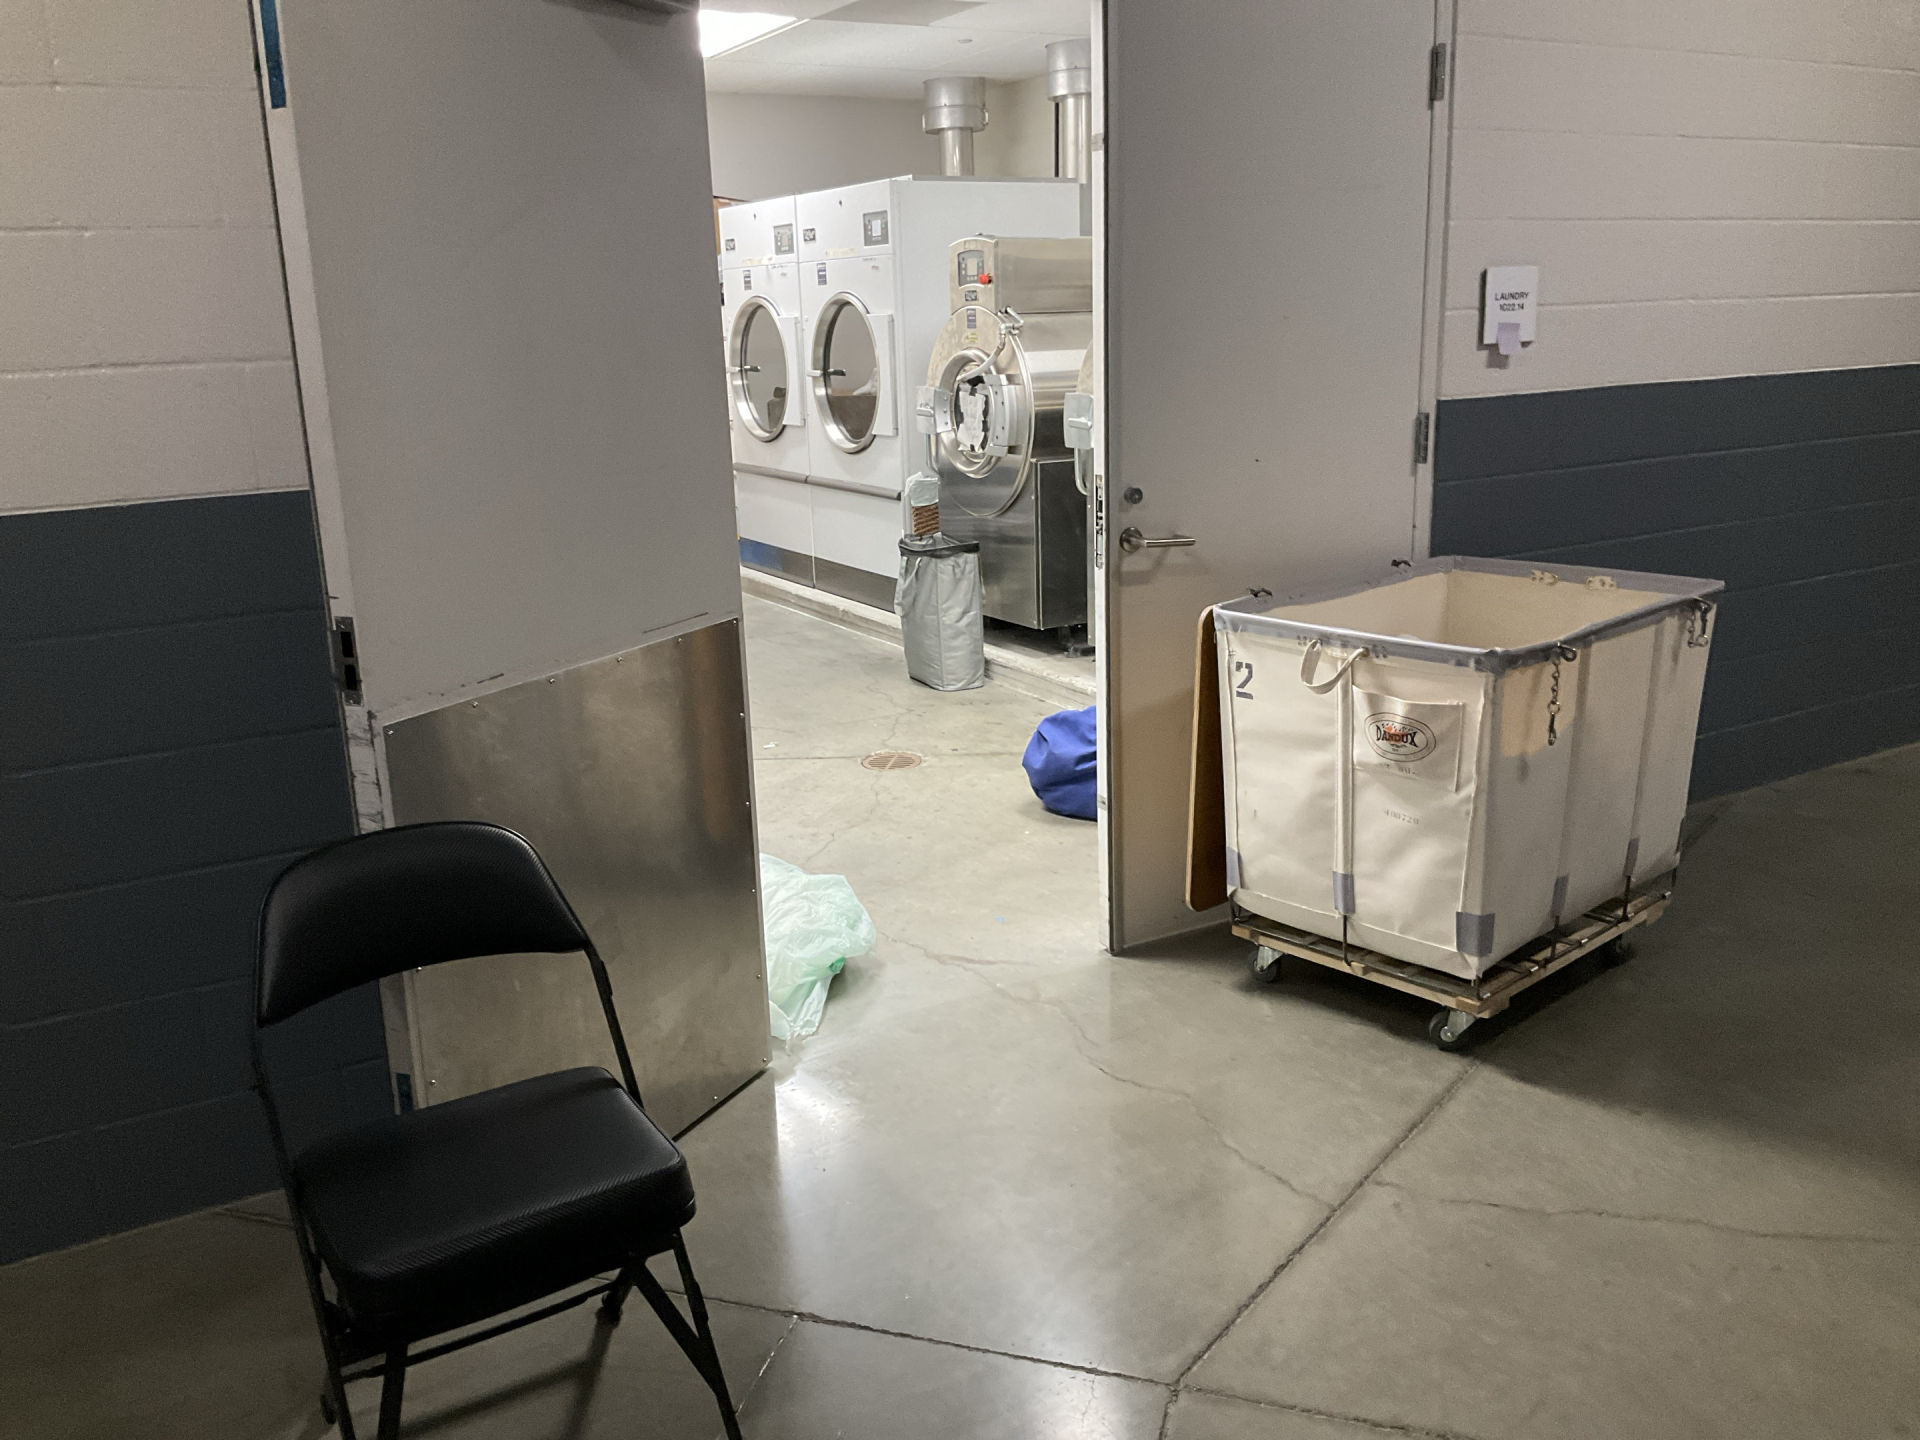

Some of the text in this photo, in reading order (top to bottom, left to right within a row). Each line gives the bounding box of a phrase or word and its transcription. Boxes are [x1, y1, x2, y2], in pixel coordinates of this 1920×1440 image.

[1494, 291, 1529, 301] LAUNDRY
[1235, 660, 1254, 700] 2
[1375, 724, 1419, 748] DANDUX
